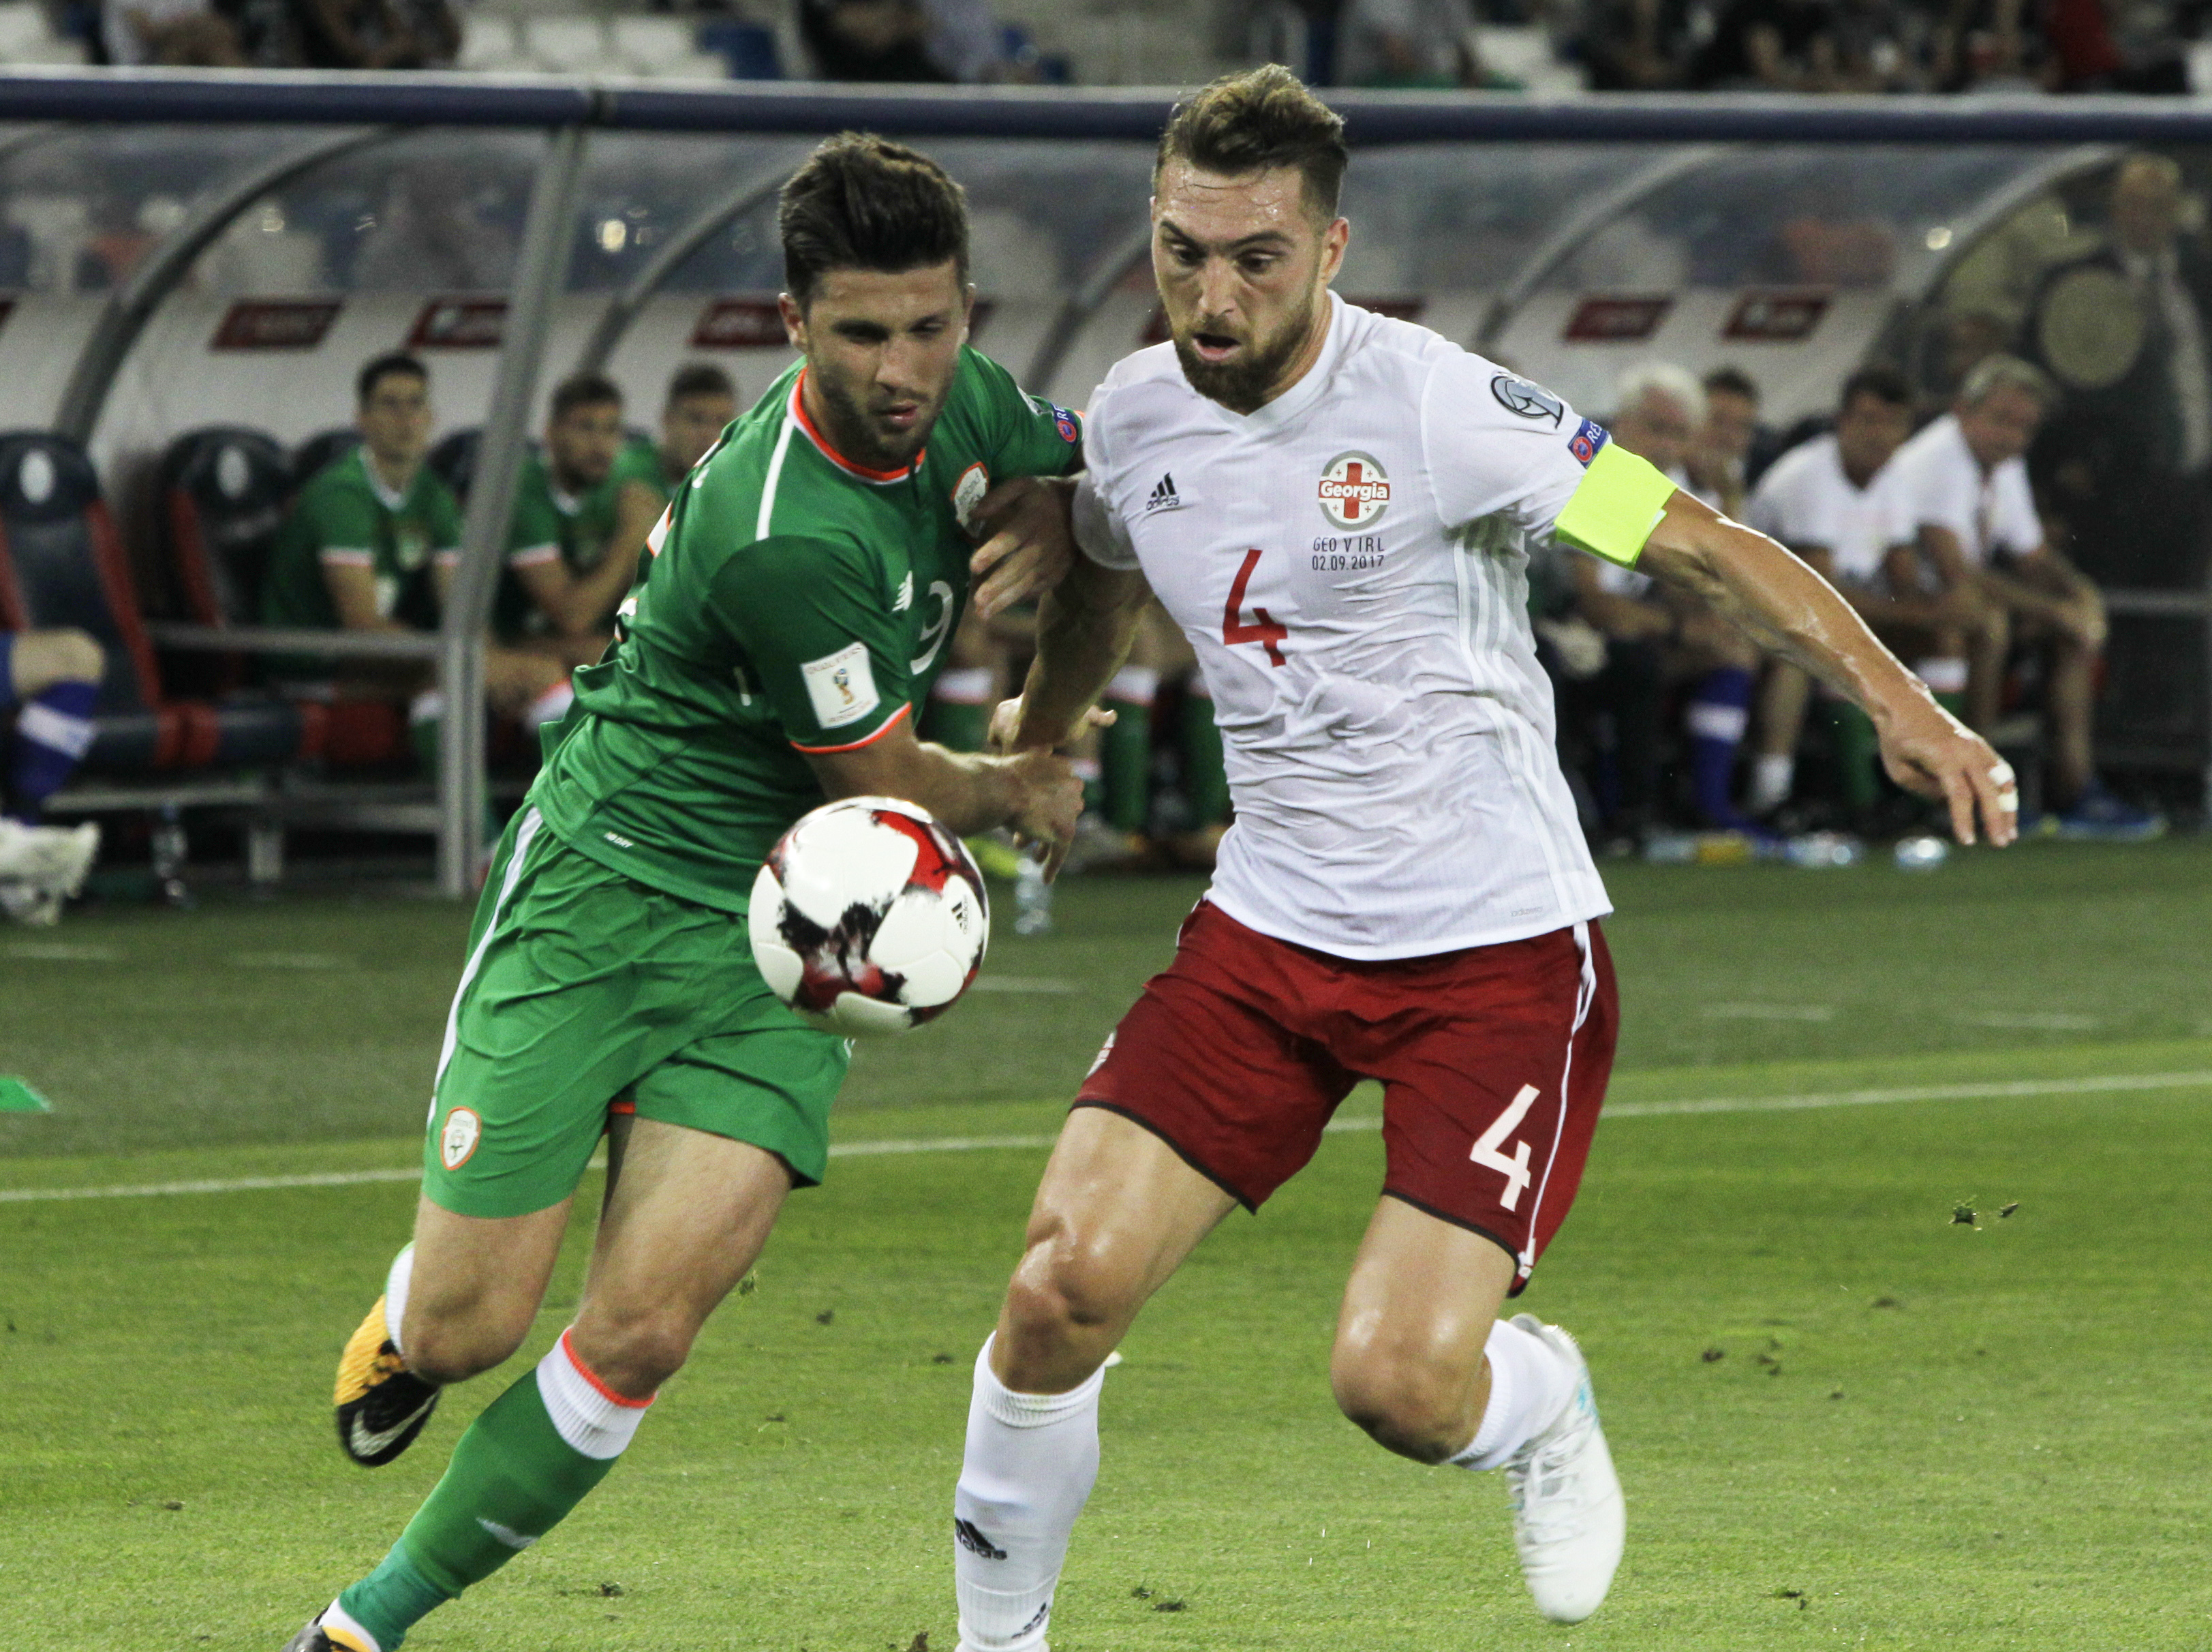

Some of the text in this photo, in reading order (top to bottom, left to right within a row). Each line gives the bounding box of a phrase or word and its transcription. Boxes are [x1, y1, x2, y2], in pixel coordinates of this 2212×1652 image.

[1321, 481, 1388, 501] Georgia
[1312, 555, 1385, 571] 02.09.2017
[1313, 537, 1385, 553] GEO V IRL
[910, 581, 953, 675] 9
[1223, 549, 1288, 667] 4
[1469, 1084, 1540, 1212] 4
